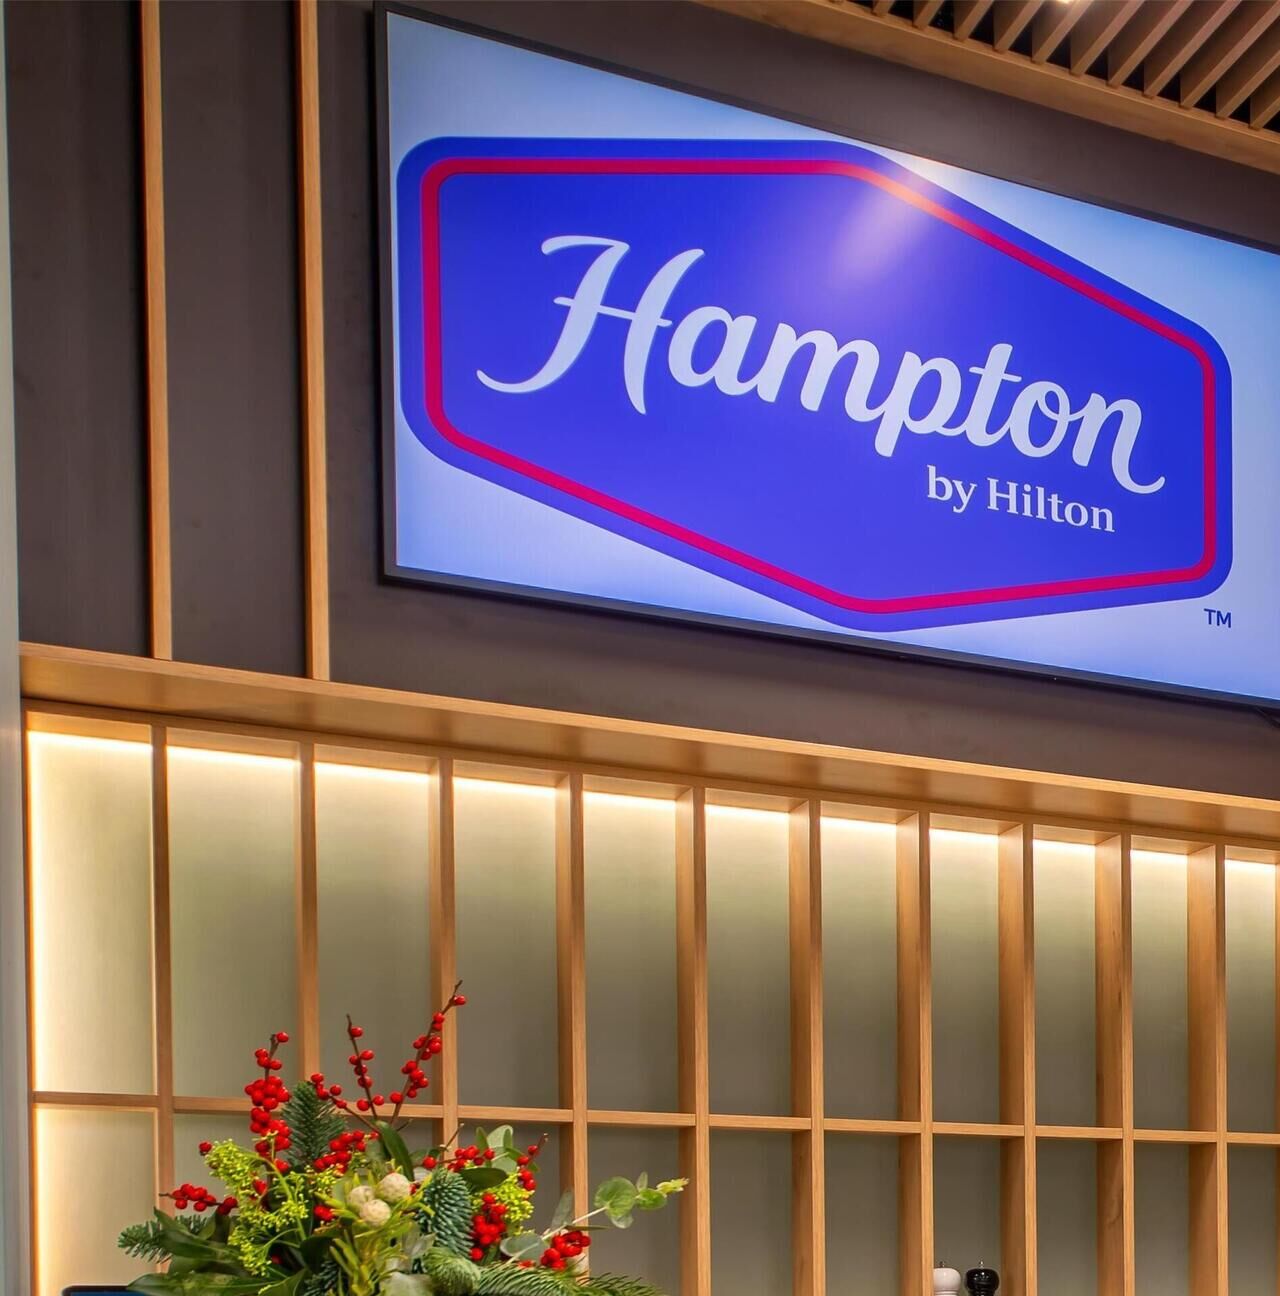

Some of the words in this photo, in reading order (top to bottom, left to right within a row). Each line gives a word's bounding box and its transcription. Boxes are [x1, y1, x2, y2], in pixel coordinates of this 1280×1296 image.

[477, 236, 1165, 494] Hampton
[927, 464, 977, 513] by
[987, 476, 1115, 533] Hilton
[1204, 608, 1232, 628] TM
